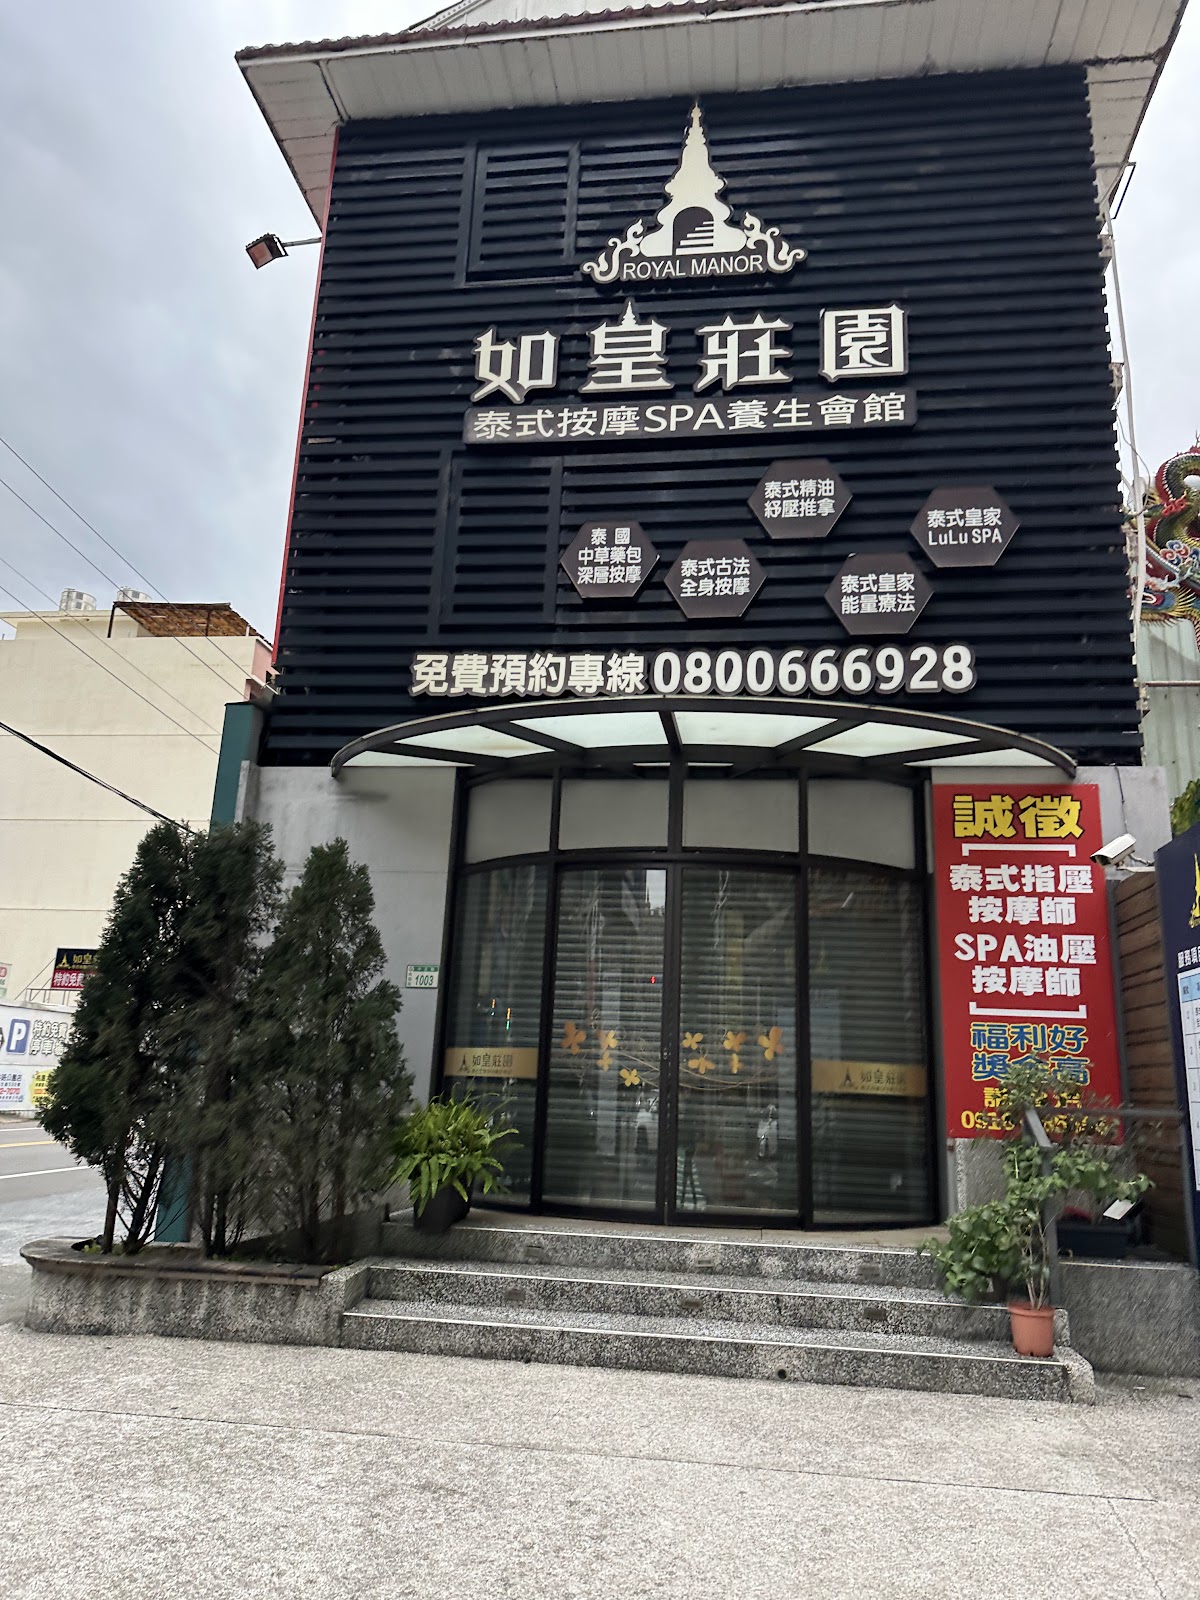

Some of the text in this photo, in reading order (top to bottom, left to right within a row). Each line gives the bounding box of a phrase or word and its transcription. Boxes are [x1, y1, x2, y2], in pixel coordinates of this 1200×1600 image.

[622, 254, 764, 279] ROYAL MANOR
[471, 300, 906, 402] 如皇莊園
[472, 392, 906, 440] 泰式按摩SPA養生會館
[764, 478, 835, 498] 泰式精油
[764, 498, 835, 519] 紓壓推拿
[927, 507, 1002, 528] 泰式皇家
[928, 528, 1002, 546] LuLu SPA
[578, 546, 642, 566] 中草藥包
[680, 557, 750, 577] 泰式古法
[577, 565, 642, 585] 深層按摩
[840, 572, 915, 593] 泰式皇家
[680, 577, 750, 597] 全身按摩
[840, 594, 916, 614] 能量療法
[652, 645, 974, 695] 0800666928
[952, 794, 1085, 839] 誠徵
[949, 864, 1094, 894] 泰式指壓
[968, 895, 1077, 925] 按摩師
[953, 933, 1097, 965] SPA油壓
[1177, 945, 1200, 969] 服務項
[415, 974, 434, 986] 1003
[971, 965, 1082, 996] 按摩師
[970, 1022, 1089, 1054] 福利好
